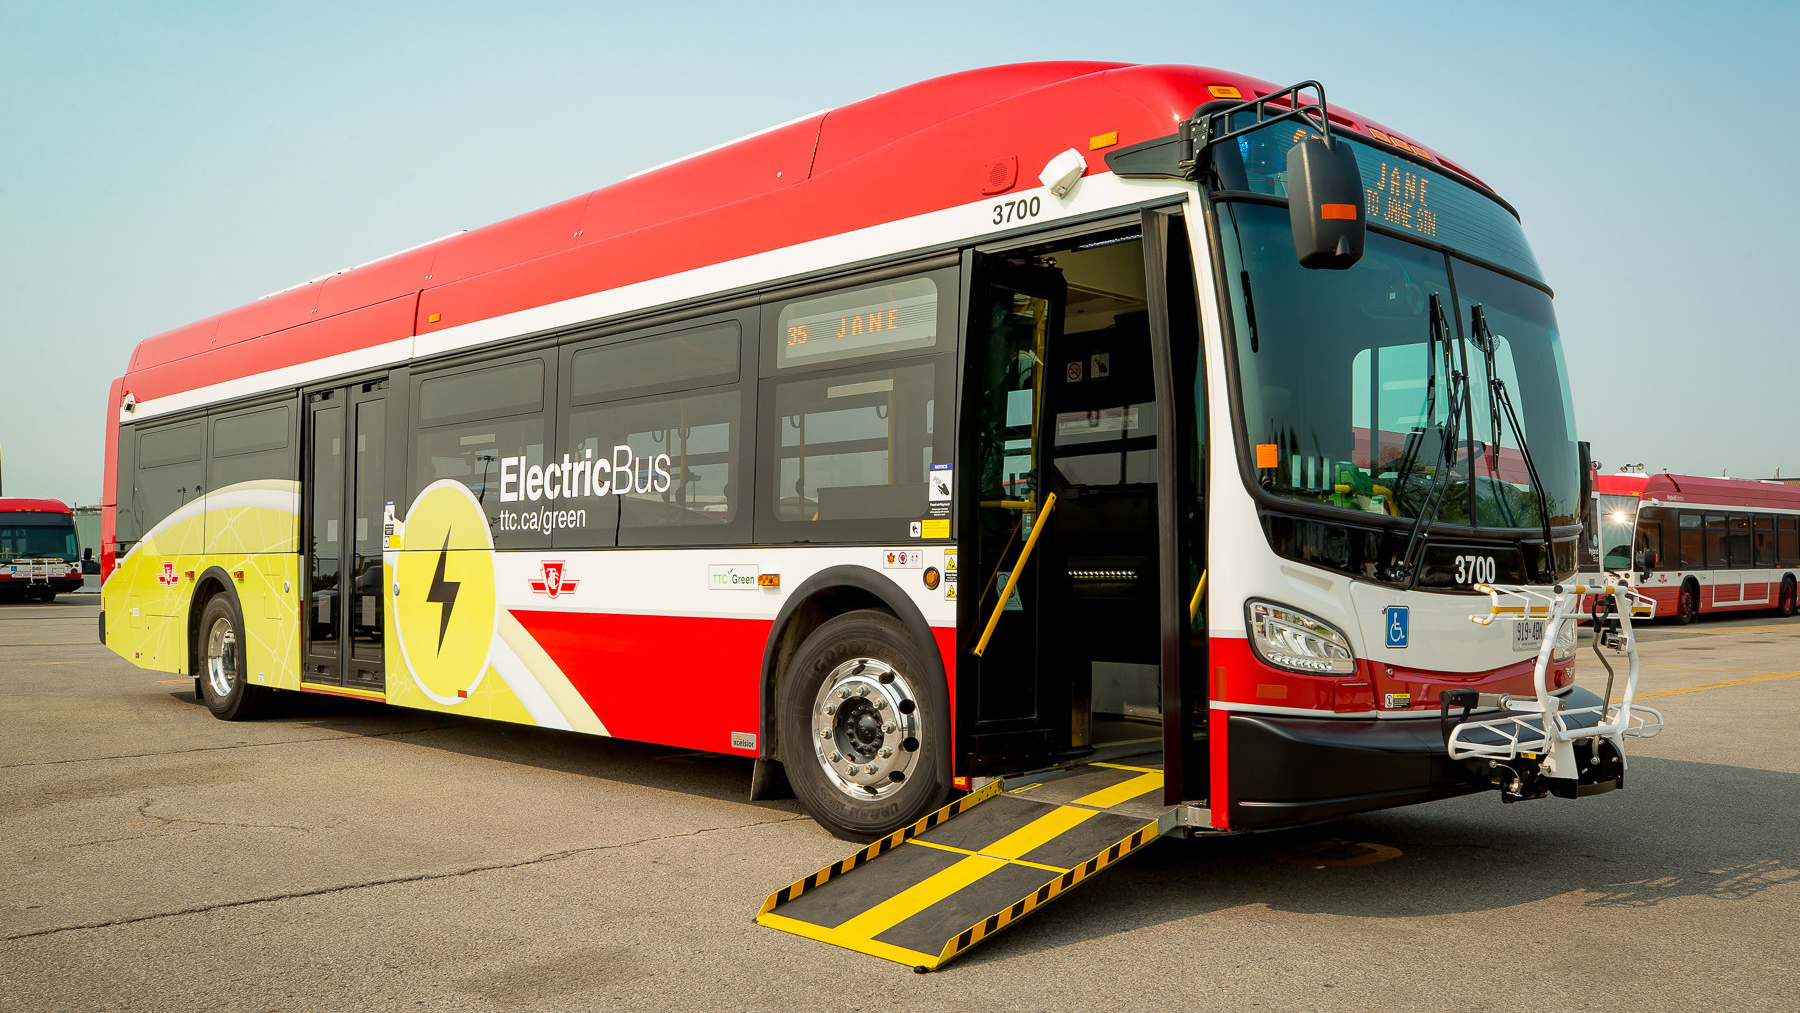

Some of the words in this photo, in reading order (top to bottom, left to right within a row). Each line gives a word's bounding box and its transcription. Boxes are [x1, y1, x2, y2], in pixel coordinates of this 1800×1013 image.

[1377, 162, 1429, 207] JANE
[992, 196, 1041, 226] 3700
[1366, 189, 1379, 217] TO
[1383, 197, 1413, 229] JANE
[787, 324, 808, 346] 35
[836, 308, 899, 338] JANE
[500, 505, 586, 535] ttc.ca/green
[712, 574, 728, 584] TTC
[731, 574, 755, 584] Green
[1455, 555, 1496, 584] 3700
